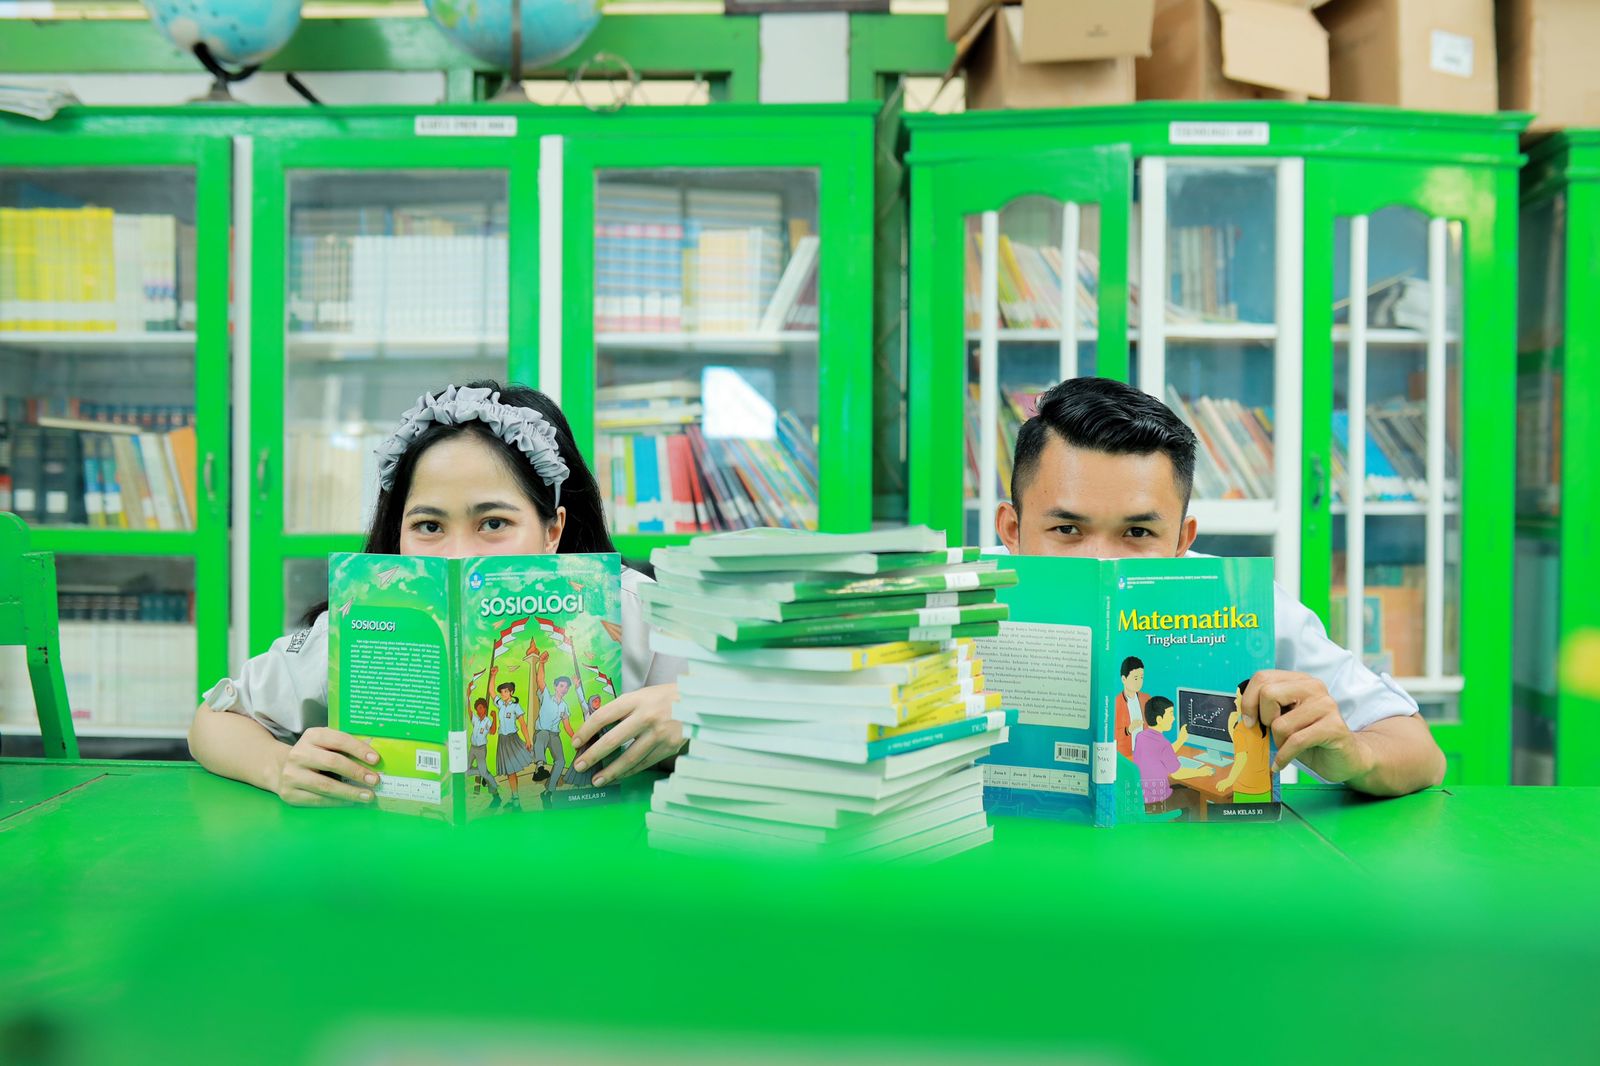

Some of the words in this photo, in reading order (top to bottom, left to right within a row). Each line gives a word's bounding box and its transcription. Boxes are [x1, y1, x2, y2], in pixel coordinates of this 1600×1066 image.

[480, 595, 584, 617] SOSIOLOGI
[351, 619, 396, 632] SOSIOLOGI
[1118, 606, 1259, 632] Matematika
[1146, 634, 1188, 648] Tingkat
[1190, 633, 1226, 647] Lanjut
